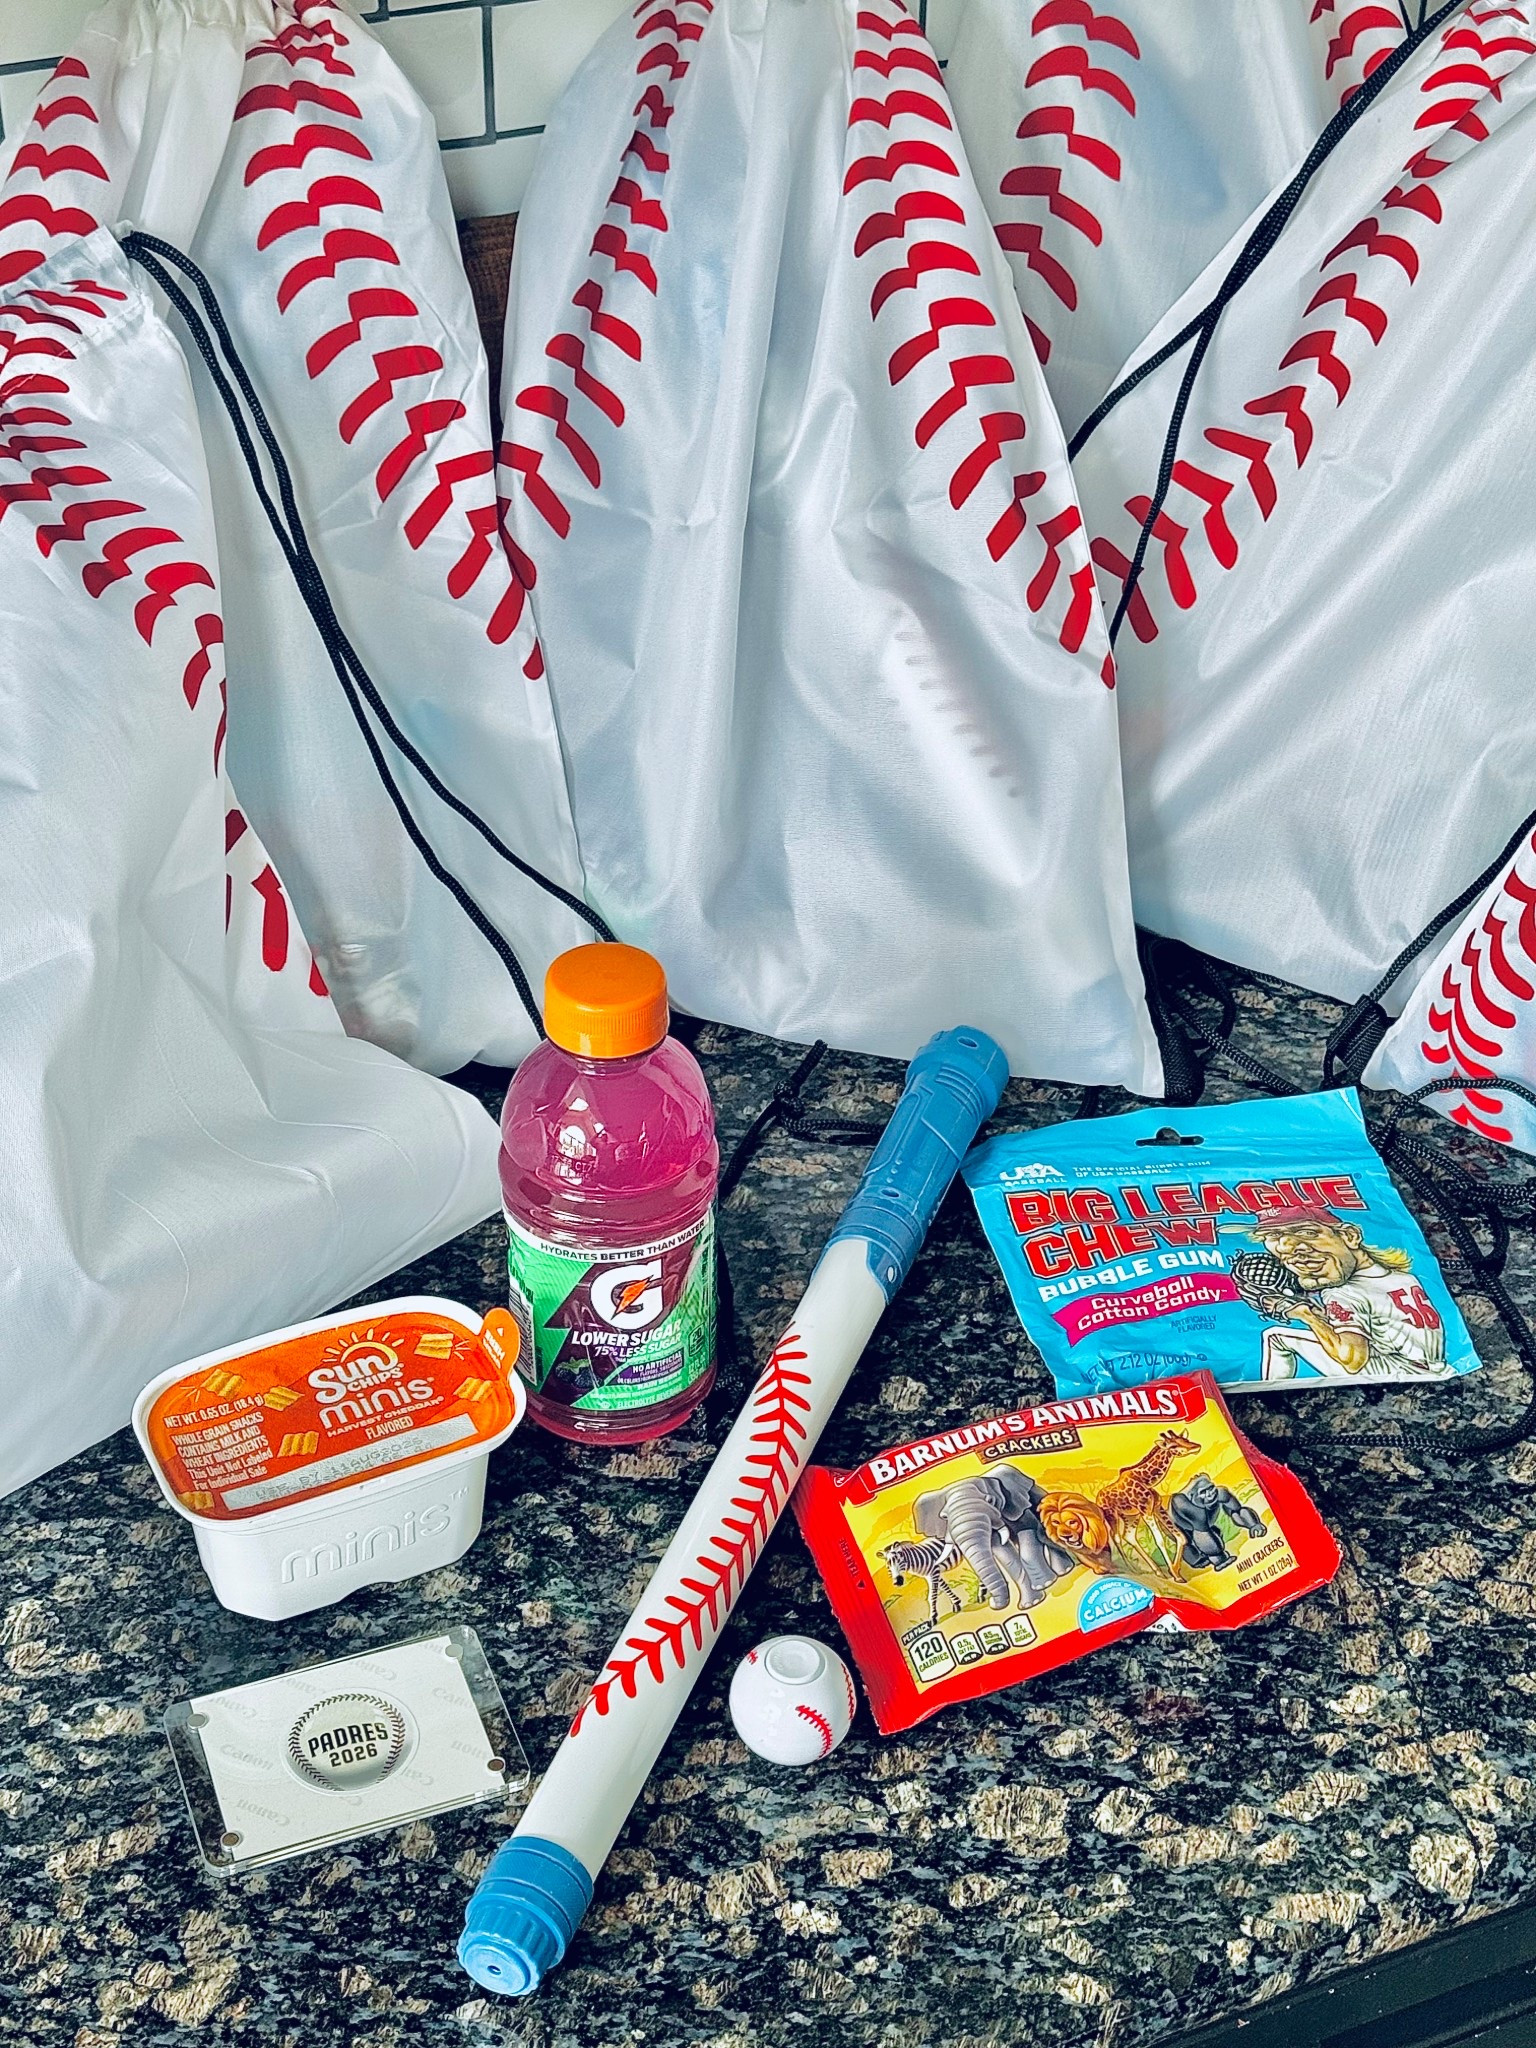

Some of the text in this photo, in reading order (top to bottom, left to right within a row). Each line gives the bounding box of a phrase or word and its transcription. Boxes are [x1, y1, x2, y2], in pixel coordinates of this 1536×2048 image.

[1004, 1175, 1368, 1235] BIG LEAGUE
[540, 1221, 705, 1261] HYDRATES BETTER THAN WATER
[1021, 1217, 1220, 1279] CHEW
[1039, 1249, 1224, 1302] BUBBLE GUM
[590, 1257, 663, 1330] G
[1091, 1276, 1194, 1310] Curveball
[1387, 1285, 1440, 1330] 56
[572, 1331, 629, 1346] LOWER
[629, 1319, 682, 1346] SUGAR
[1078, 1306, 1149, 1331] Cotton
[1170, 1314, 1217, 1329] ARTIFICIALLY
[1178, 1322, 1216, 1334] FLAVORED
[595, 1345, 618, 1357] 75%
[620, 1345, 646, 1358] LESS
[648, 1333, 681, 1353] SUGAR
[632, 1364, 644, 1373] NO
[646, 1350, 682, 1370] ARTIFICIAL
[308, 1354, 398, 1404] Sun
[347, 1367, 404, 1392] CHIPS
[164, 1415, 182, 1428] NET
[182, 1412, 200, 1426] WT.
[200, 1407, 219, 1421] 0.65
[218, 1404, 234, 1416] OZ.
[319, 1380, 434, 1429] minis
[328, 1400, 439, 1438] HARVEST CHEDDAR
[172, 1412, 264, 1446] WHOLE GRAIN SNACKS
[177, 1425, 261, 1458] CONTAINS MILK AND
[365, 1416, 414, 1440] FLAVORED
[868, 1389, 1178, 1486] BARNUM'S ANIMALS
[182, 1434, 268, 1468] WHEAT INGREDIENTS
[984, 1430, 1074, 1460] CRACKERS
[187, 1447, 274, 1480] This Unit Not Labeled
[193, 1465, 268, 1490] For Individual Sale
[1236, 1536, 1284, 1574] MINI CRACKERS
[1238, 1553, 1294, 1592] NET WT 1 OZ (28g)
[1084, 1588, 1148, 1621] CALCIUM
[914, 1636, 943, 1662] 120
[918, 1652, 950, 1672] CALORIES
[308, 1722, 388, 1758] PADRES
[328, 1743, 378, 1768] 2026
[221, 1744, 274, 1770] Canon
[236, 1799, 290, 1827] Canon
